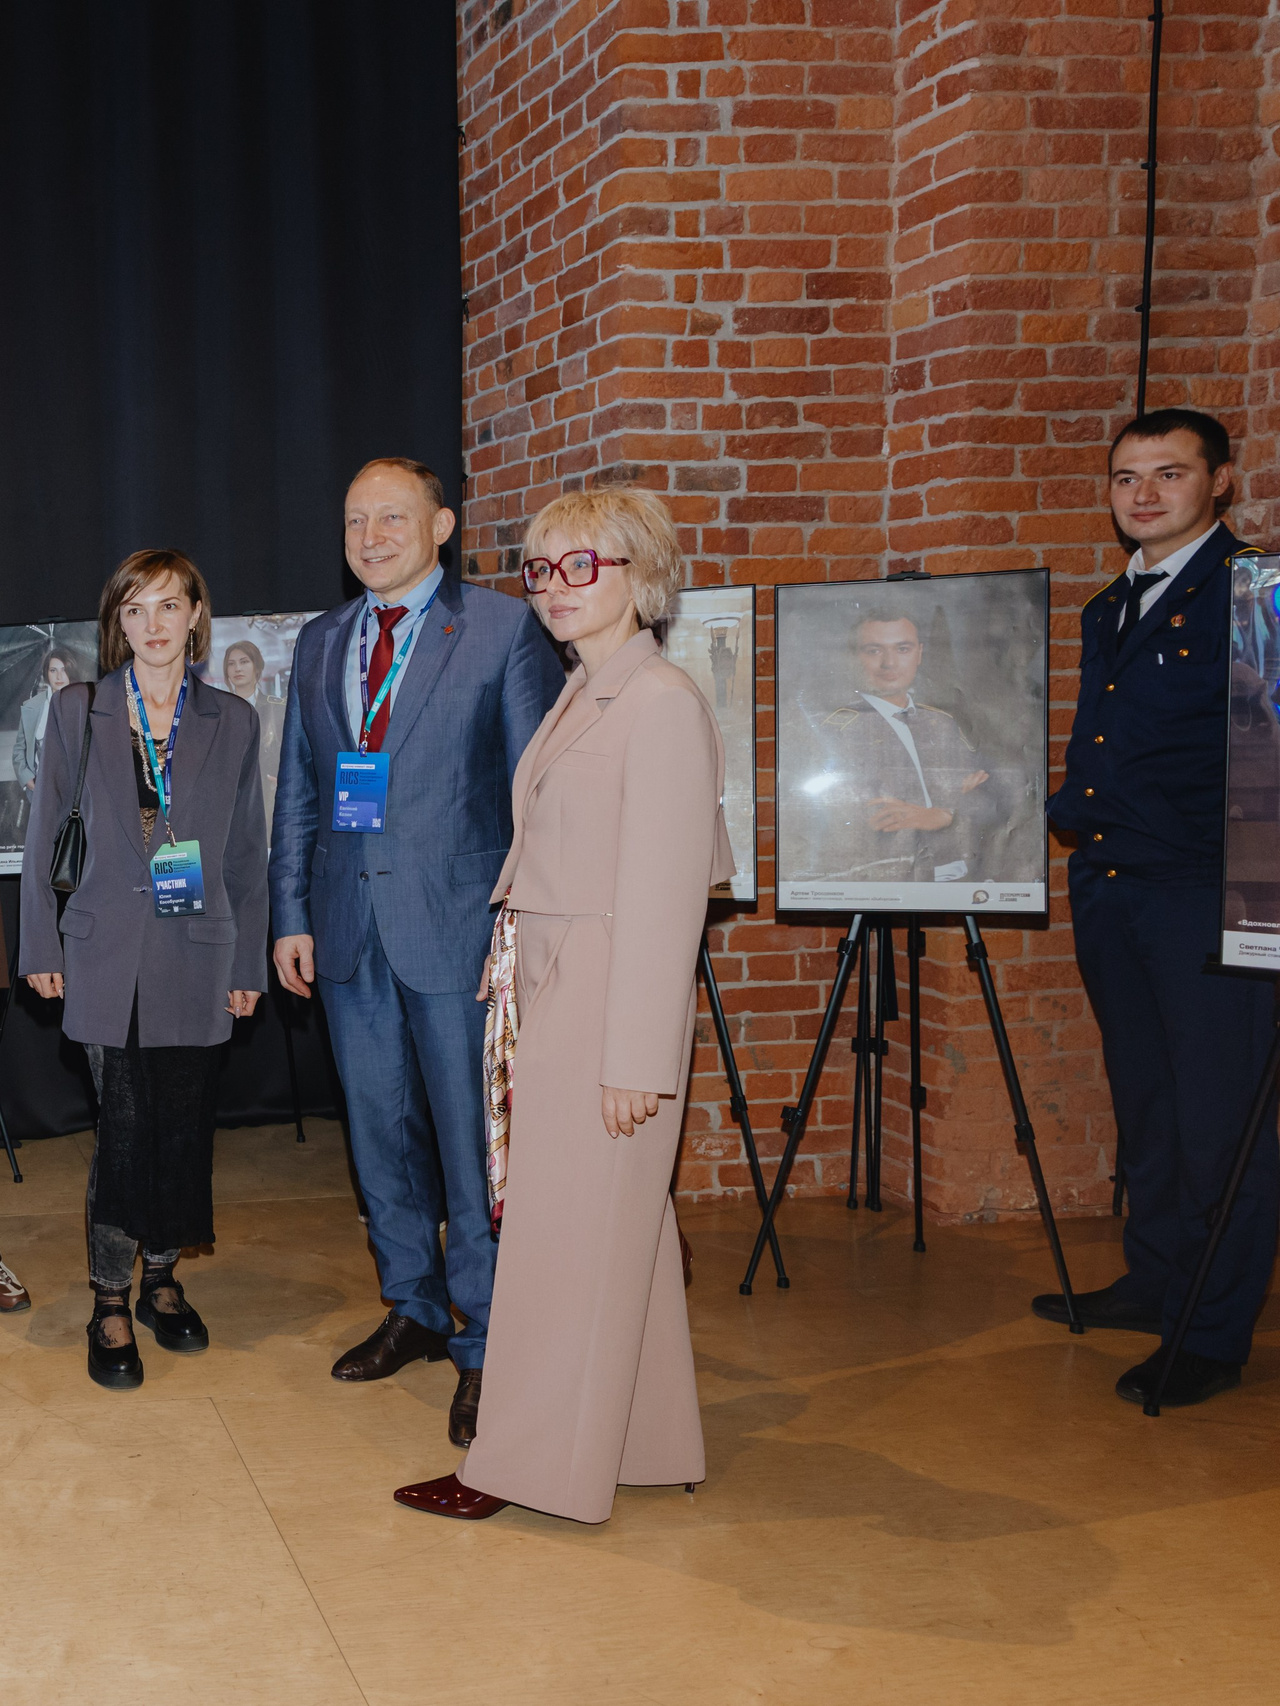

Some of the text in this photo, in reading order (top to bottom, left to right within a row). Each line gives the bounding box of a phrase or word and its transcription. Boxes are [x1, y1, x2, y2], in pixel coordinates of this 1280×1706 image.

[340, 771, 359, 785] RICS
[339, 791, 349, 801] VIP
[154, 861, 173, 875] RICS
[156, 878, 187, 890] УЧАСТНИК
[1239, 943, 1277, 952] Светлана
